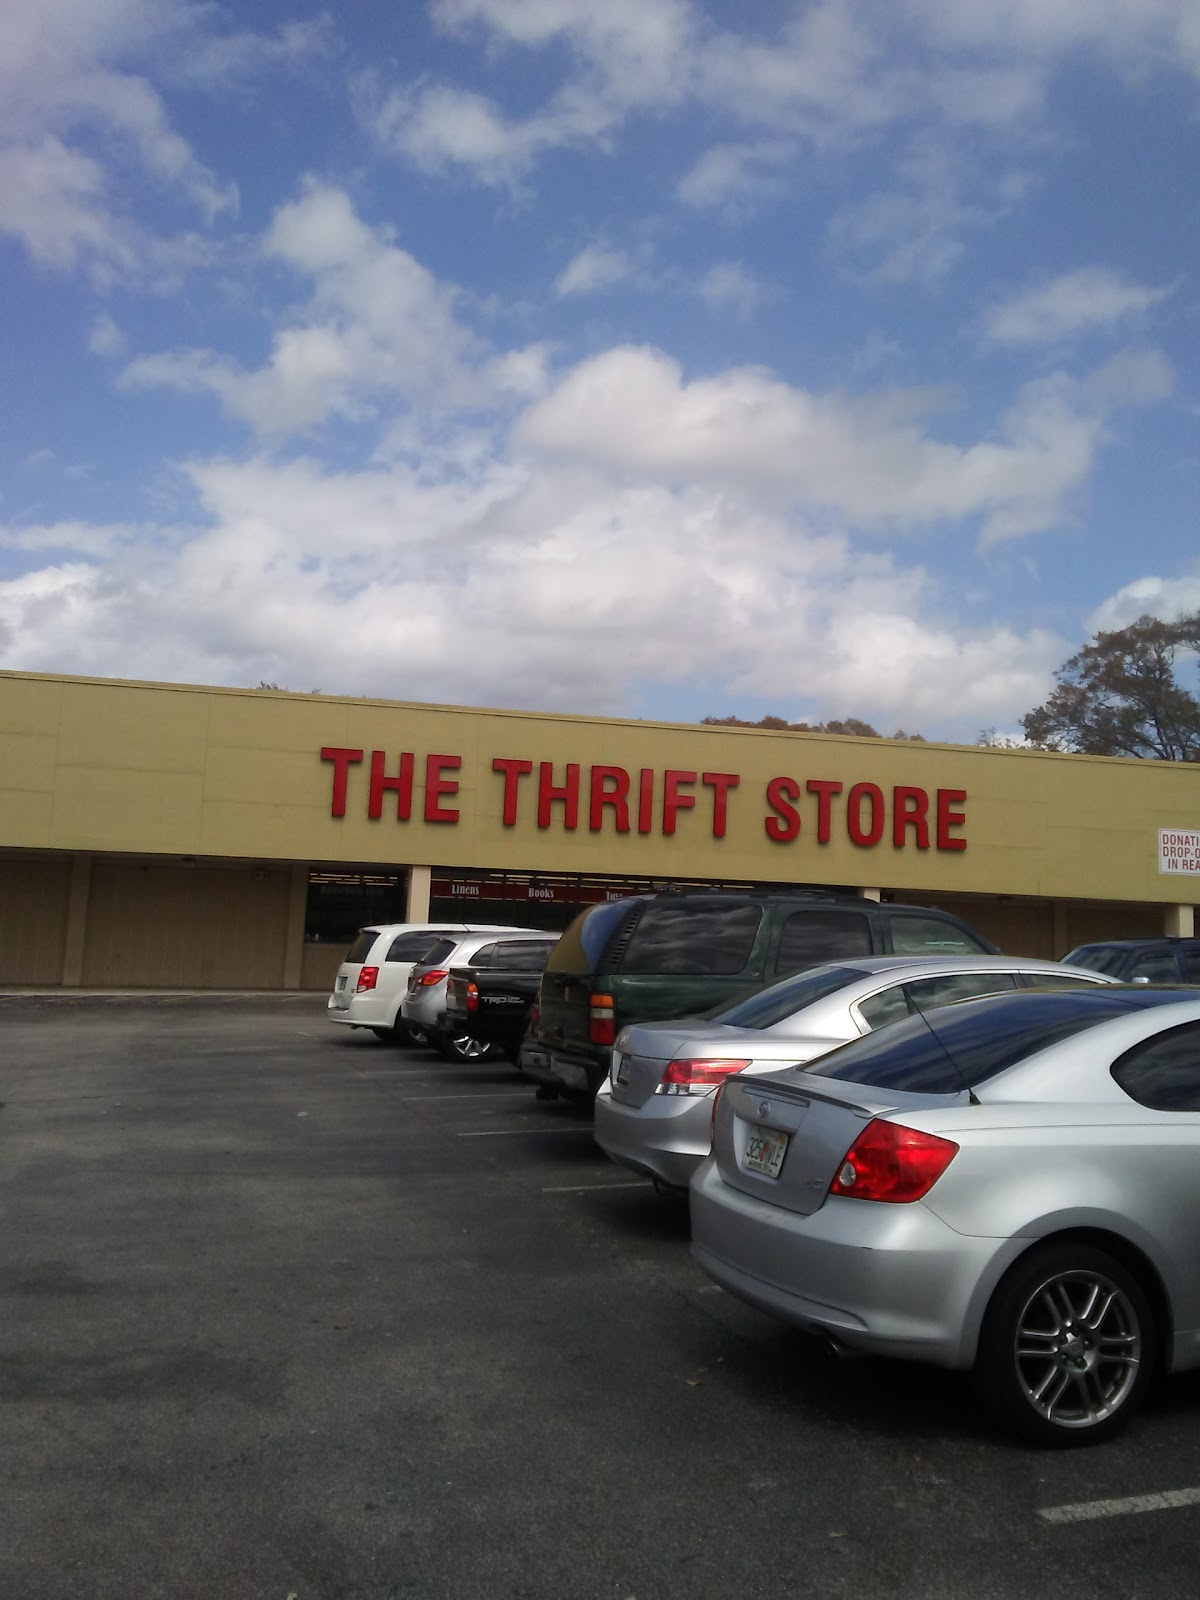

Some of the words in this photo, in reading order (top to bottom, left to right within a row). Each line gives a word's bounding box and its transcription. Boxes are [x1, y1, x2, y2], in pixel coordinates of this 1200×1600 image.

[321, 747, 462, 824] THE
[492, 758, 740, 838] THRIFT
[765, 776, 968, 851] STORE
[1167, 858, 1178, 870] IN
[451, 884, 480, 895] Linens
[528, 887, 554, 898] Books
